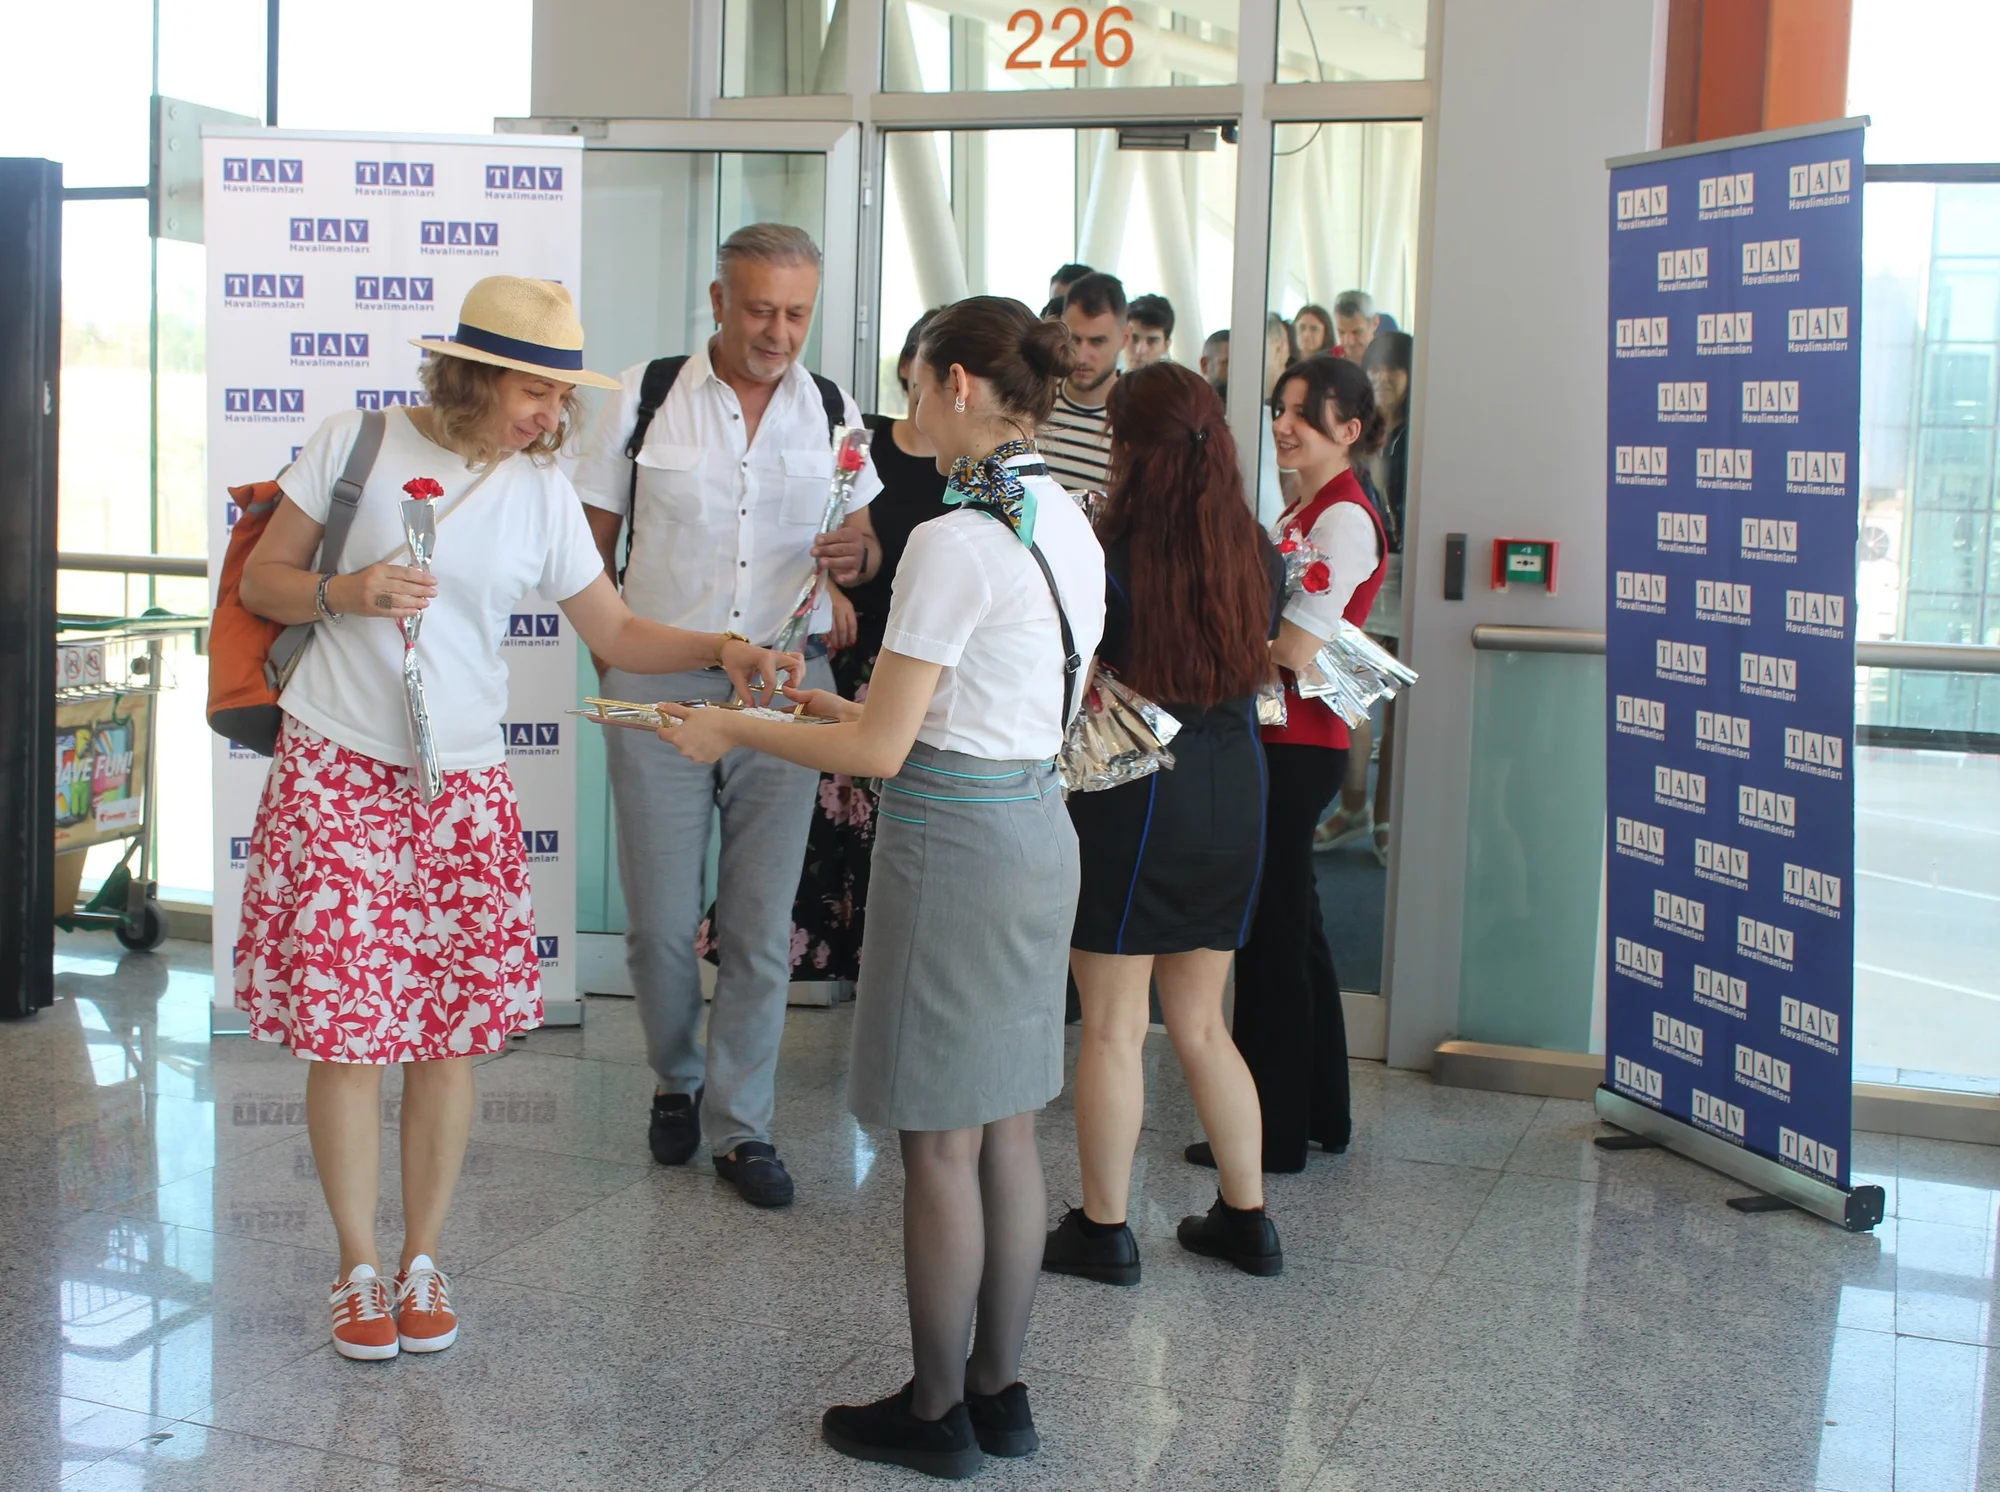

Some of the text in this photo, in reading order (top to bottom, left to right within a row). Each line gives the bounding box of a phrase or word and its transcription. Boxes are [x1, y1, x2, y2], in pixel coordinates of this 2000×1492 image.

[1005, 6, 1134, 69] 226
[227, 161, 300, 180] TAV
[359, 165, 431, 184] TAV
[489, 168, 559, 188] TAV
[1792, 161, 1848, 195] TAV
[223, 183, 304, 193] Havalimanları
[355, 186, 435, 197] Havalimanları
[485, 190, 563, 201] Havalimanları
[1702, 175, 1751, 206] TAV
[1620, 188, 1665, 217] TAV
[293, 221, 366, 240] TAV
[424, 224, 495, 243] TAV
[289, 243, 370, 253] Havalimanları
[420, 246, 499, 256] Havalimanları
[1745, 241, 1798, 271] TAV
[1660, 250, 1706, 278] TAV
[228, 277, 301, 295] TAV
[359, 279, 430, 298] TAV
[224, 298, 305, 308] Havalimanları
[355, 301, 434, 311] Havalimanları
[1619, 319, 1665, 345] TAV
[1700, 314, 1750, 341] TAV
[1791, 309, 1846, 338] TAV
[294, 335, 366, 354] TAV
[290, 358, 370, 367] Havalimanları
[228, 391, 301, 410] TAV
[1660, 384, 1705, 409] TAV
[1745, 383, 1797, 409] TAV
[224, 413, 305, 423] Havalimanları
[1618, 449, 1665, 473] TAV
[1699, 450, 1750, 477] TAV
[1790, 453, 1843, 481] TAV
[1660, 514, 1705, 541] TAV
[1744, 520, 1795, 549] TAV
[1619, 574, 1664, 601] TAV
[1699, 582, 1749, 612] TAV
[1789, 593, 1842, 625] TAV
[510, 616, 557, 636] AV
[1659, 642, 1704, 672] TAV
[1744, 655, 1794, 688] TAV
[1619, 697, 1662, 728] TAV
[509, 725, 557, 745] AV
[1699, 713, 1748, 746] TAV
[1788, 730, 1840, 766] TAV
[95, 750, 133, 779] FUN!
[1658, 768, 1703, 801] TAV
[1742, 788, 1793, 824] TAV
[1619, 819, 1662, 853] TAV
[1698, 841, 1746, 877] TAV
[1786, 865, 1838, 905] TAV
[1657, 892, 1702, 928] TAV
[1741, 919, 1791, 958] TAV
[1619, 940, 1660, 976] TAV
[1697, 968, 1744, 1006] TAV
[1656, 1014, 1700, 1053] TAV
[1784, 999, 1836, 1041] TAV
[1618, 1059, 1659, 1096] TAV
[1739, 1047, 1788, 1089] TAV
[1696, 1091, 1742, 1134] TAV
[1783, 1130, 1835, 1176] TAV
